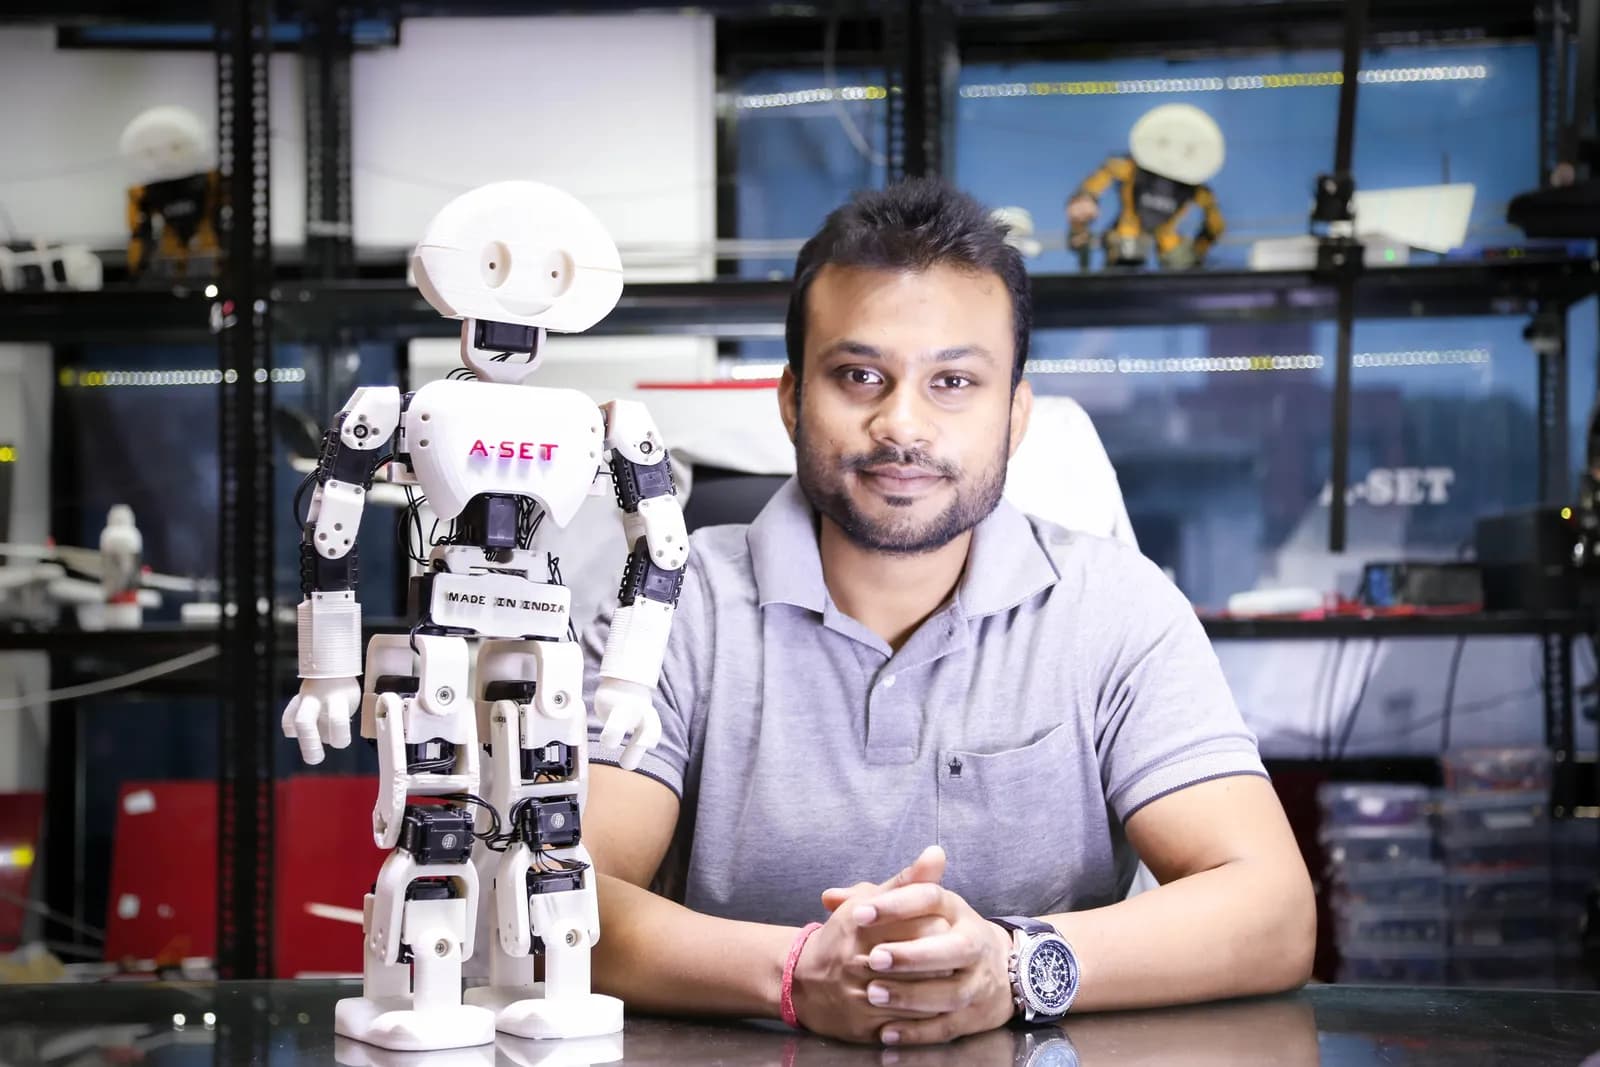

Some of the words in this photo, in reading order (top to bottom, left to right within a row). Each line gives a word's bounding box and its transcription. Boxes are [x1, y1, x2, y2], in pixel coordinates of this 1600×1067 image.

[469, 439, 559, 461] A-SET
[447, 591, 486, 605] MADE
[495, 597, 517, 608] IN
[521, 599, 566, 614] INDIA
